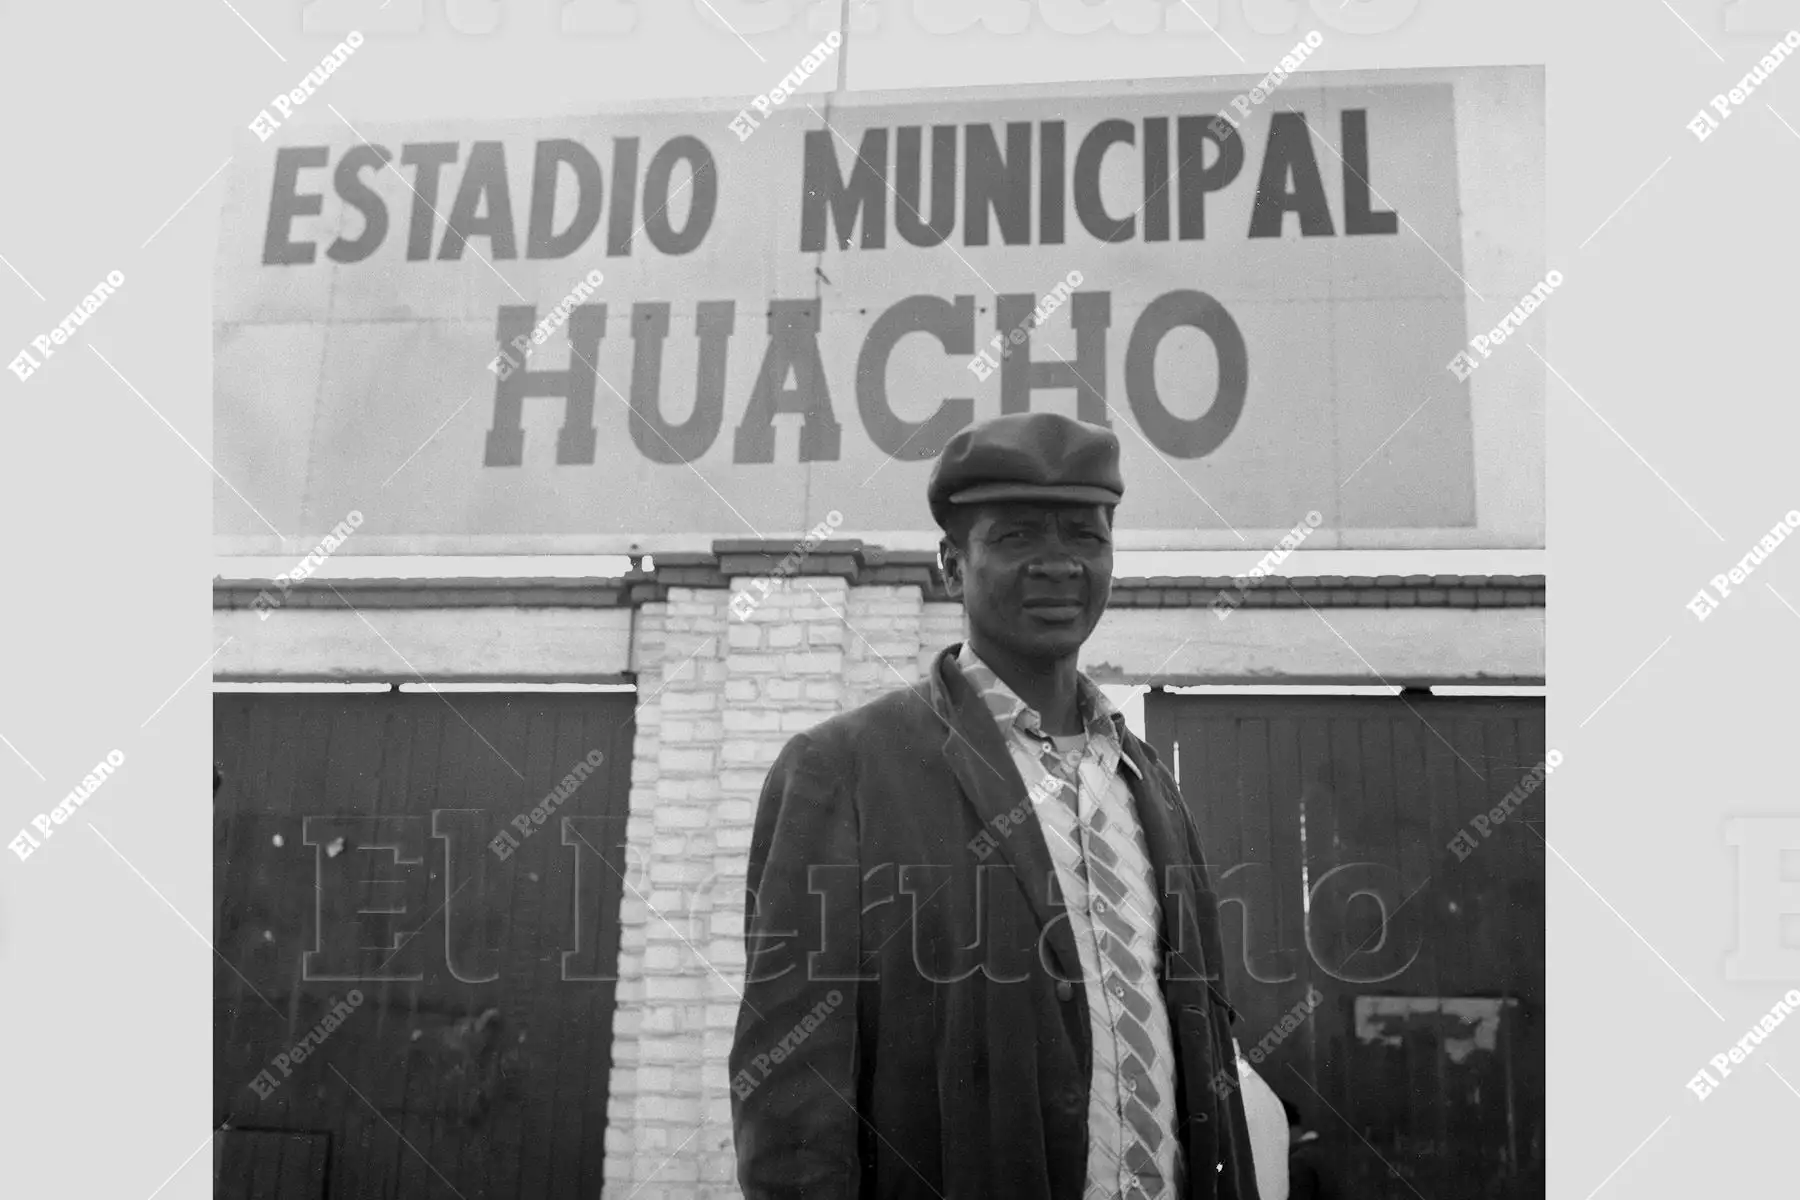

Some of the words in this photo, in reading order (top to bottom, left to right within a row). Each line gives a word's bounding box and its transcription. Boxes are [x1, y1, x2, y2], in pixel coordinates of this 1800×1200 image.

[261, 135, 718, 266] ESTADIO
[800, 109, 1398, 253] MUNICIPAL
[483, 289, 1249, 467] HUACHO
